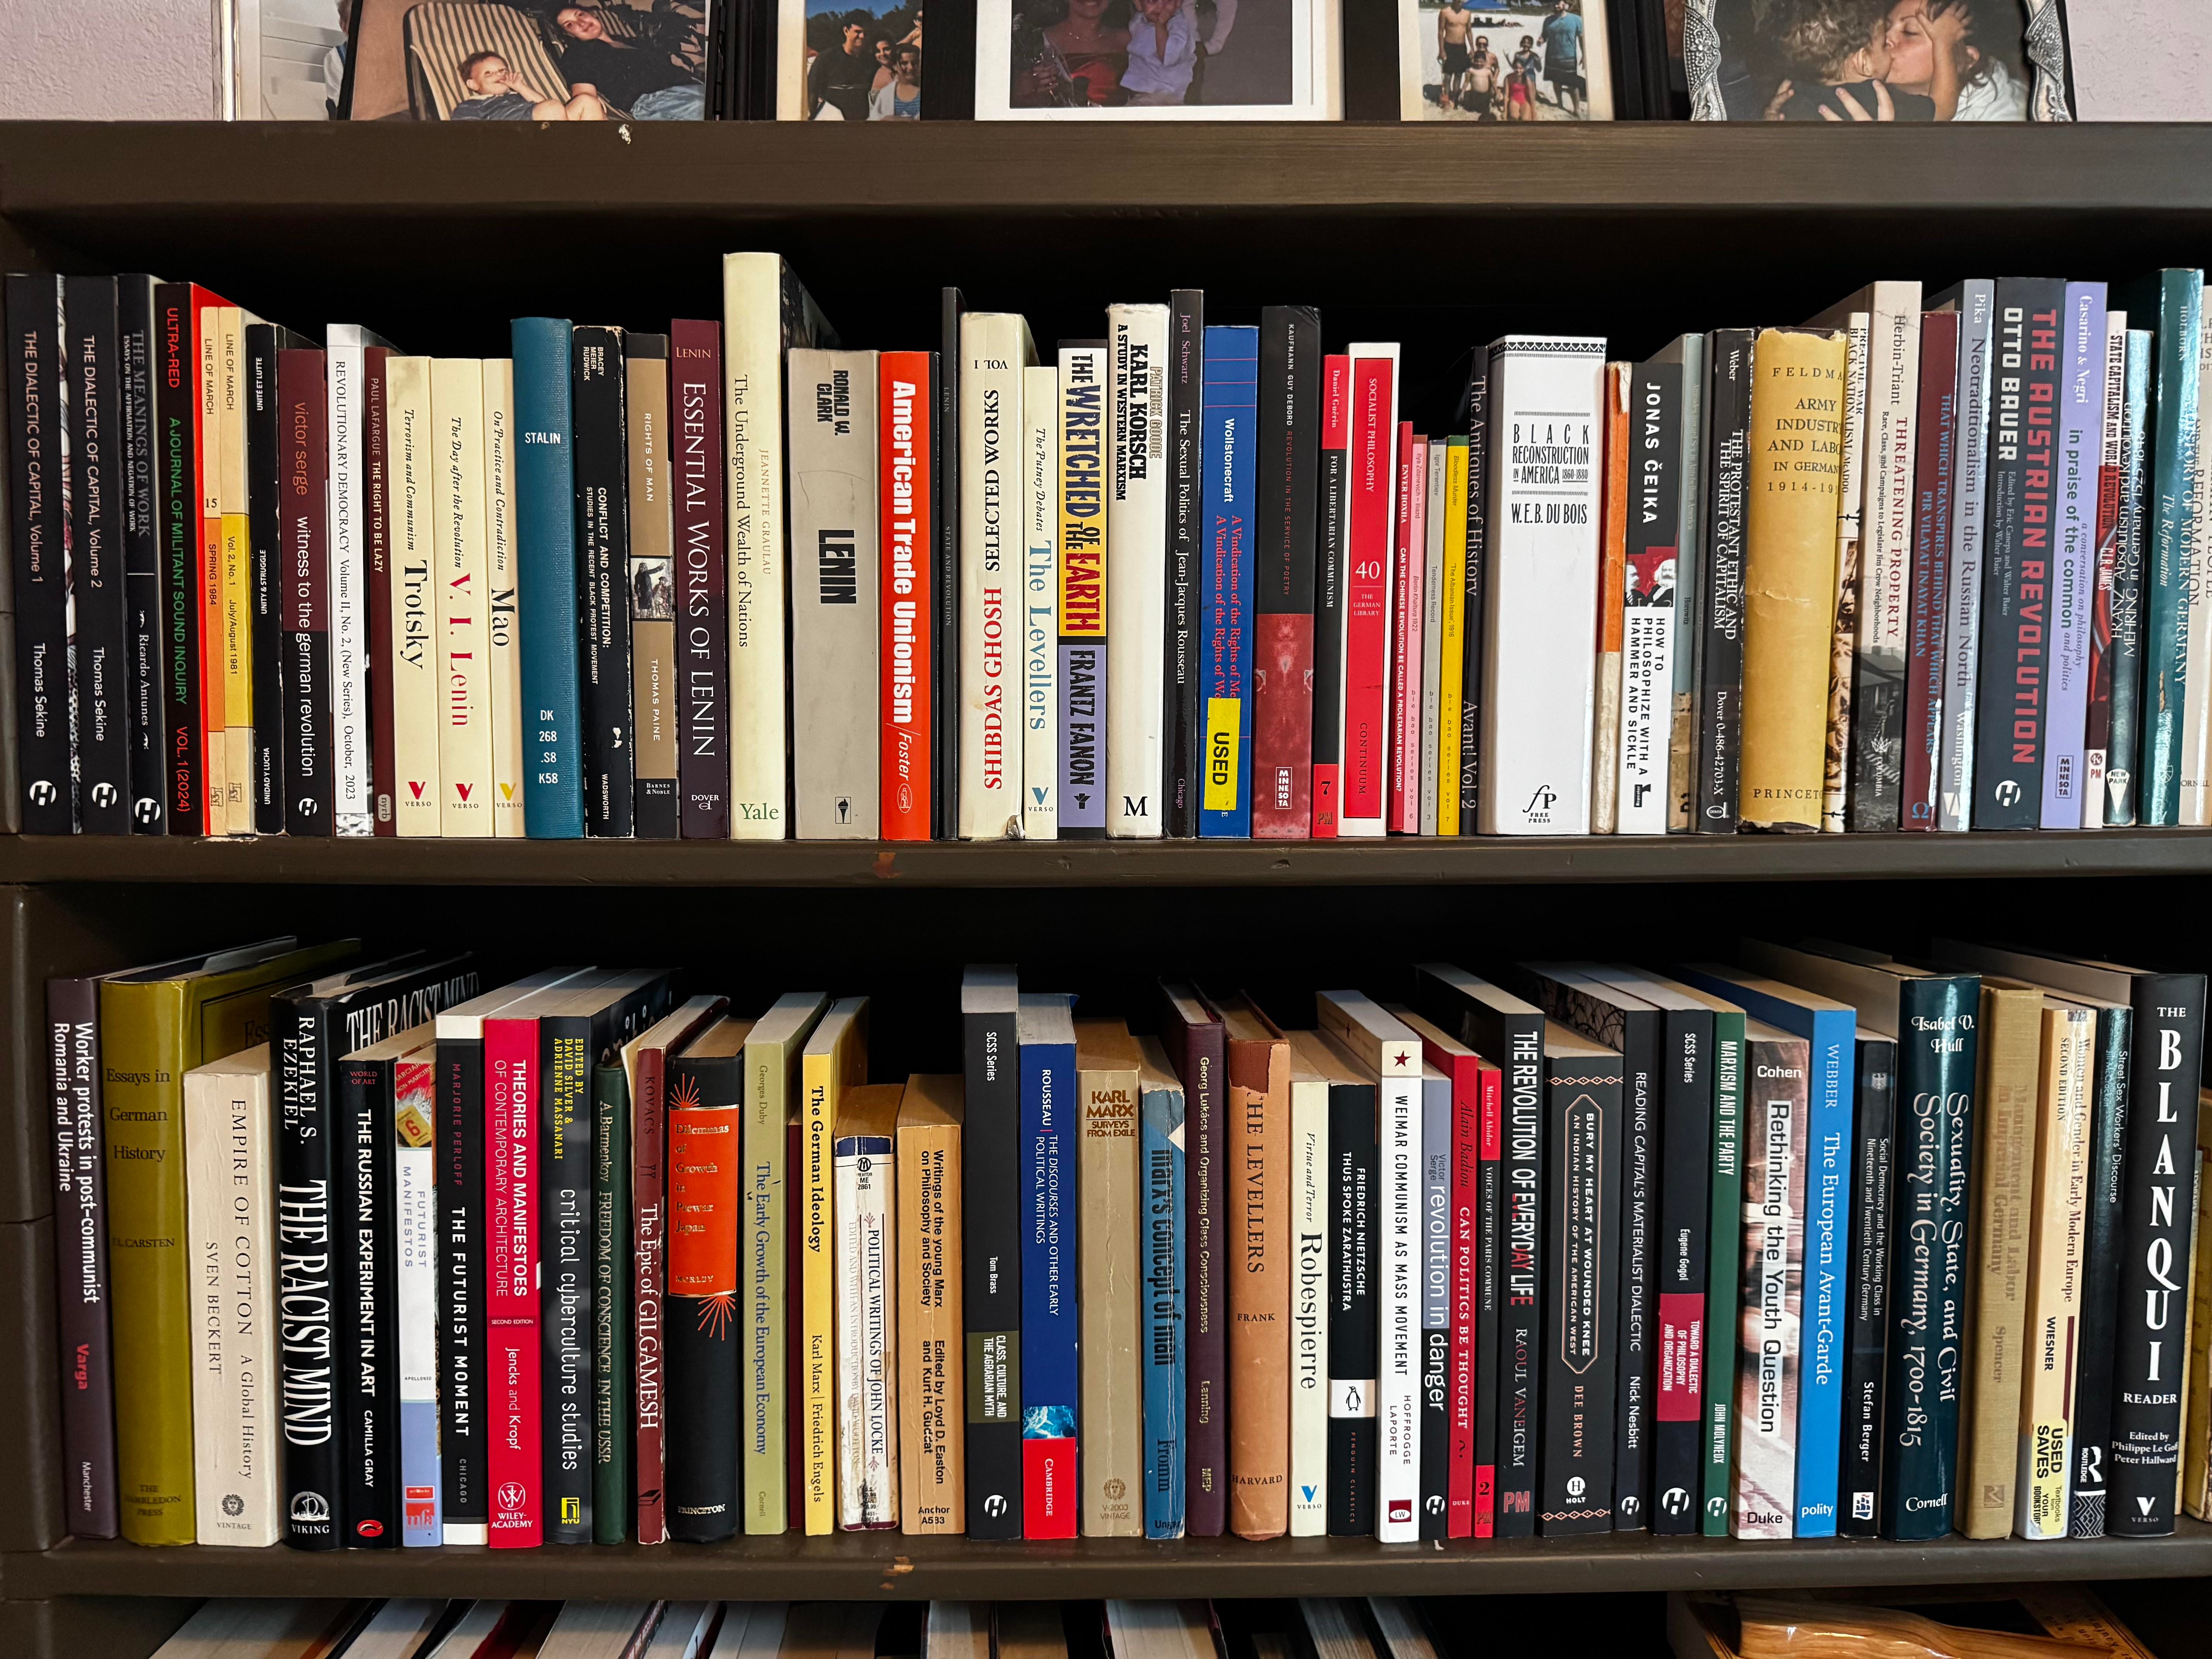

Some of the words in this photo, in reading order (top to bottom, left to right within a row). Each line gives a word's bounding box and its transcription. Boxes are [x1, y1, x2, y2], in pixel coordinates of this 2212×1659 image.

[24, 331, 37, 358] THE
[167, 307, 180, 387] ULTRA-RED
[676, 347, 711, 358] LENIN
[2002, 307, 2023, 368] OTTO
[2030, 309, 2056, 370] THE
[226, 359, 234, 373] OF
[1130, 344, 1147, 398] KARL
[25, 362, 39, 434] DIALECTIC
[735, 374, 748, 405] The
[816, 383, 833, 422] CLARK
[833, 370, 850, 416] RONALD
[1368, 378, 1377, 428] SOCIALIST
[1795, 398, 1836, 411] ARMY
[295, 402, 309, 447] victor
[336, 361, 347, 469] REVOLUTIONARY
[525, 432, 560, 444] STALIN
[834, 420, 850, 436] W.
[1645, 383, 1661, 449] JONAS
[1998, 377, 2020, 460] BAUER
[2069, 429, 2083, 443] in
[27, 438, 40, 458] OF
[684, 383, 706, 512] ESSENTIAL
[732, 410, 750, 510] Underground
[893, 381, 915, 514] American
[1128, 402, 1147, 479] KORSCH
[1224, 418, 1234, 502] Wollstonecraft
[1366, 430, 1375, 492] PHILOSOPHY
[1512, 445, 1589, 464] RECONSTRUCTION
[292, 451, 308, 495] serge
[646, 459, 653, 474] OF
[1891, 417, 1907, 541] THREATENING
[2023, 383, 2053, 547] AUSTRIAN
[2066, 450, 2081, 500] praise
[28, 461, 41, 520] CAPITAL,
[338, 472, 349, 553] DEMOCRACY
[1546, 503, 1560, 524] DU
[1563, 503, 1587, 524] BOIS
[1643, 460, 1662, 523] ČEIKA
[2066, 505, 2080, 521] of
[297, 516, 311, 577] witness
[737, 514, 751, 566] Wealth
[893, 518, 916, 594] Trade
[2064, 526, 2078, 553] the
[449, 573, 471, 599] V.
[687, 520, 710, 617] WORKS
[738, 571, 752, 588] of
[818, 529, 856, 603] LENIN
[1029, 540, 1051, 591] The
[1355, 561, 1379, 579] 40
[298, 581, 311, 597] to
[1887, 548, 1902, 637] PROPERTY
[2061, 559, 2078, 628] common
[298, 601, 313, 628] the
[400, 559, 429, 669] Trotsky
[449, 617, 471, 635] I.
[491, 587, 515, 646] Mao
[738, 590, 752, 647] Nations
[984, 587, 1001, 678] GHOSH
[139, 634, 150, 677] Ricardo
[295, 632, 311, 693] german
[690, 627, 709, 659] OF
[893, 601, 916, 723] Unionism
[2013, 560, 2044, 763] REVOLUTION
[33, 642, 46, 692] Thomas
[450, 652, 474, 725] Lenin
[1029, 605, 1051, 730] Levellers
[1070, 650, 1095, 716] FRANTZ
[34, 696, 48, 737] Sekine
[140, 680, 150, 726] Antunes
[541, 710, 554, 721] DK
[691, 671, 715, 756] LENIN
[176, 726, 188, 757] VOL.
[300, 699, 316, 776] revolution
[343, 725, 354, 768] October,
[539, 730, 557, 742] 268
[541, 752, 556, 763] .S8
[898, 732, 912, 781] Foster
[984, 685, 1002, 789] SHIBDAS
[1070, 723, 1095, 785] FANON
[1212, 732, 1230, 785] USED
[1358, 722, 1367, 793] CONTINUUM
[175, 769, 190, 812] (2024)
[345, 775, 356, 799] 2023
[539, 773, 558, 783] K58
[739, 802, 779, 819] Yale
[1123, 795, 1148, 816] M
[2156, 1007, 2186, 1017] THE
[75, 1022, 94, 1081] Worker
[1756, 1065, 1801, 1079] Cohen
[103, 1067, 150, 1085] Essays
[153, 1067, 175, 1085] in
[1042, 1069, 1051, 1125] ROUSSEAU
[1092, 1089, 1130, 1104] KARL
[1825, 1044, 1839, 1108] WEBBER
[73, 1087, 95, 1149] protests
[109, 1106, 171, 1122] German
[811, 1085, 824, 1116] The
[1085, 1104, 1137, 1119] MARX
[1395, 1095, 1408, 1146] WEIMAR
[79, 1155, 97, 1169] in
[113, 1143, 169, 1163] History
[232, 1100, 248, 1185] EMPIRE
[811, 1120, 823, 1183] German
[234, 1196, 249, 1225] OF
[279, 1179, 328, 1243] THE
[1247, 1144, 1264, 1272] LEVELLERS
[1395, 1154, 1408, 1234] COMMUNISM
[75, 1176, 101, 1303] post-communist
[452, 1207, 465, 1242] THE
[560, 1189, 580, 1263] critical
[641, 1203, 658, 1235] The
[808, 1187, 824, 1252] Ideology
[1430, 1186, 1449, 1297] revolution
[636, 1239, 659, 1274] Epic
[989, 1256, 998, 1271] Tom
[1395, 1241, 1407, 1256] AS
[235, 1236, 252, 1334] COTTON
[452, 1252, 467, 1346] FUTURIST
[641, 1278, 658, 1295] of
[989, 1273, 998, 1294] Brass
[1395, 1264, 1407, 1298] MASS
[280, 1251, 330, 1359] RACIST
[1295, 1232, 1322, 1388] Robespierre
[1430, 1306, 1448, 1324] in
[556, 1273, 580, 1394] cyberculture
[1395, 1306, 1407, 1375] MOVEMENT
[2044, 1316, 2056, 1371] WIESNER
[74, 1344, 89, 1389] Varga
[505, 1347, 520, 1385] Jencks
[639, 1300, 658, 1429] GILGAMESH
[1424, 1334, 1448, 1411] danger
[283, 1364, 331, 1445] MIND
[454, 1356, 469, 1436] MOMENT
[509, 1389, 520, 1410] and
[1574, 1385, 1583, 1408] DEE
[1629, 1376, 1640, 1401] Nick
[1863, 1381, 1874, 1419] Stefan
[2123, 1392, 2177, 1404] READER
[364, 1410, 373, 1456] CAMILLA
[505, 1415, 521, 1450] Kropf
[1573, 1413, 1583, 1456] BROWN
[1628, 1406, 1640, 1448] Nesbitt
[1714, 1403, 1726, 1422] JOHN
[562, 1403, 582, 1470] studies
[1713, 1424, 1725, 1463] MOLYNEUX
[1859, 1424, 1872, 1462] Berger
[2036, 1425, 2049, 1478] SAVES
[2048, 1427, 2063, 1473] USED
[364, 1458, 373, 1487] GRAY
[1044, 1458, 1053, 1516] CAMBRIDGE
[1747, 1511, 1782, 1523] Duke
[1802, 1503, 1838, 1521] polity
[1905, 1495, 1946, 1511] Cornell
